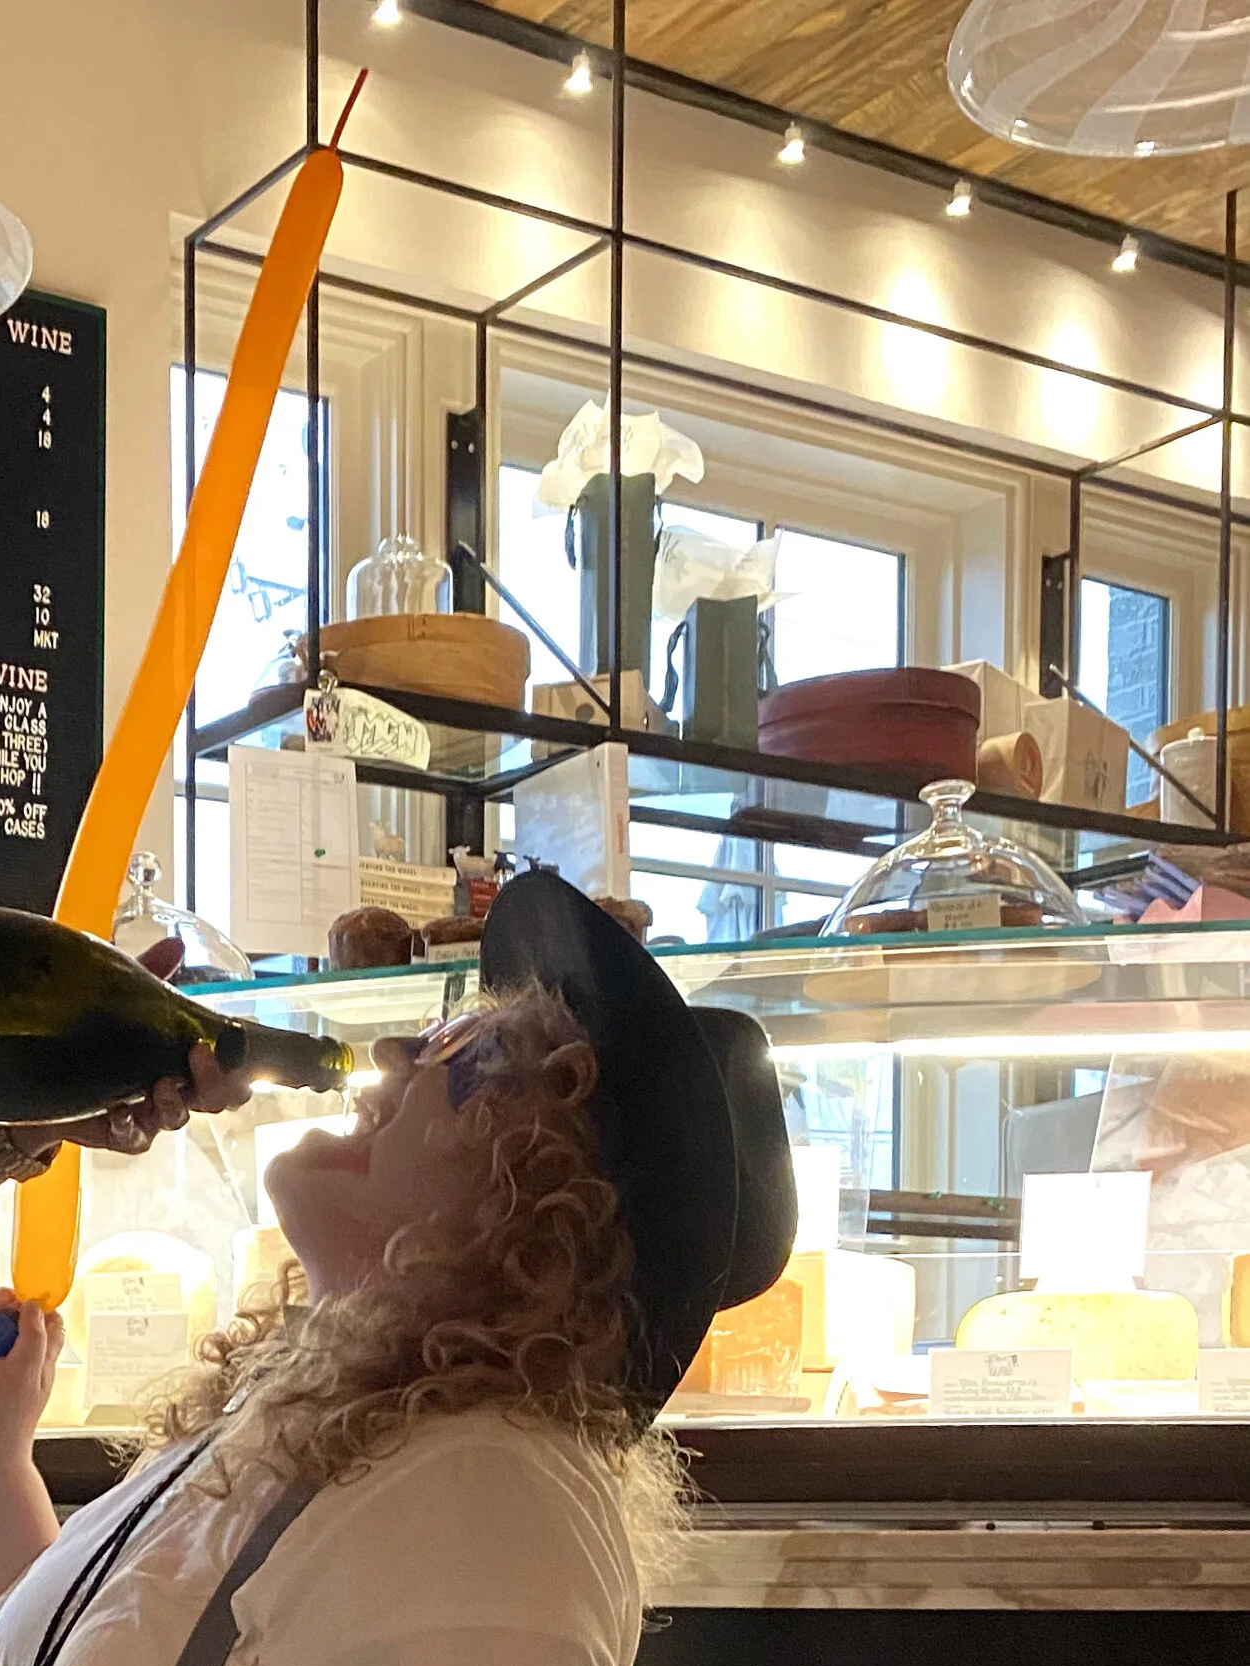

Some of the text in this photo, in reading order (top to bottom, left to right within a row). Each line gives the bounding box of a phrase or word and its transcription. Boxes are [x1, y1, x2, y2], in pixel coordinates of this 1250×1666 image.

[7, 318, 72, 355] WINE
[41, 385, 50, 404] 4
[42, 408, 51, 426] 4
[33, 583, 51, 604] 32
[35, 606, 50, 626] 10
[33, 628, 59, 650] MKT
[38, 702, 47, 719] A
[4, 713, 46, 736] GLASS
[2, 731, 48, 754] THREE)
[23, 752, 47, 773] YOU
[23, 802, 48, 822] OFF
[4, 817, 46, 839] CASES
